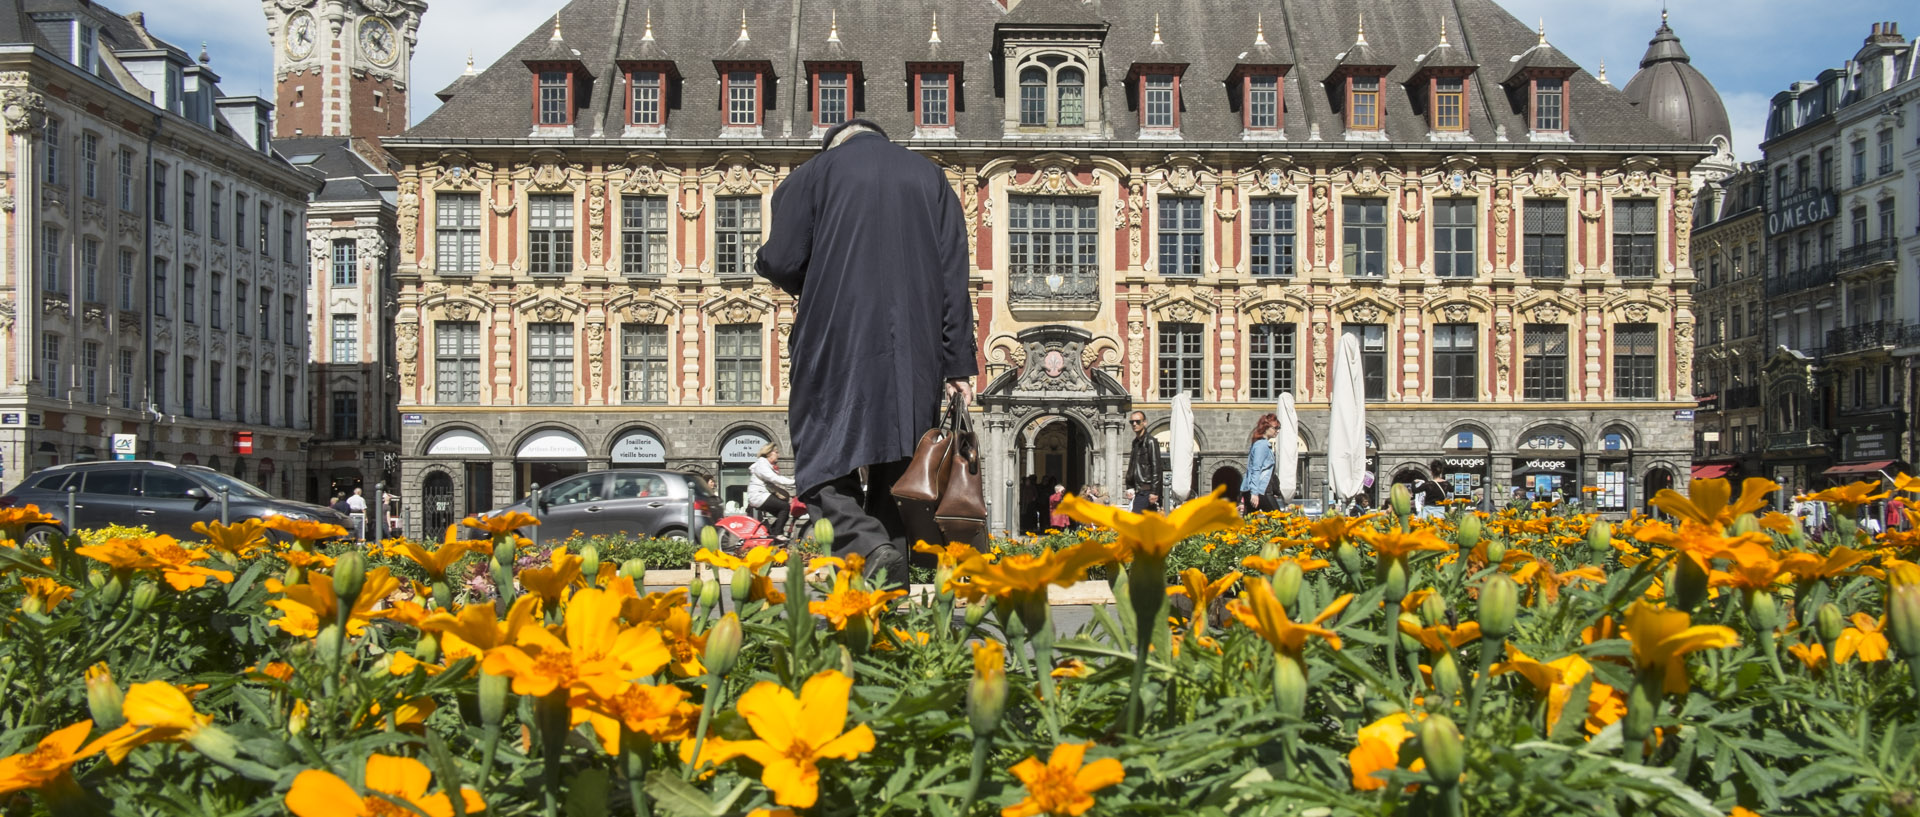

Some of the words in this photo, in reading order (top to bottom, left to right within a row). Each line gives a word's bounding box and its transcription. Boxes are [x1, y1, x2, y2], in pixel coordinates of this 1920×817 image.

[1769, 196, 1829, 235] OMEGA
[1445, 458, 1485, 468] voyages
[1526, 460, 1566, 470] voyages
